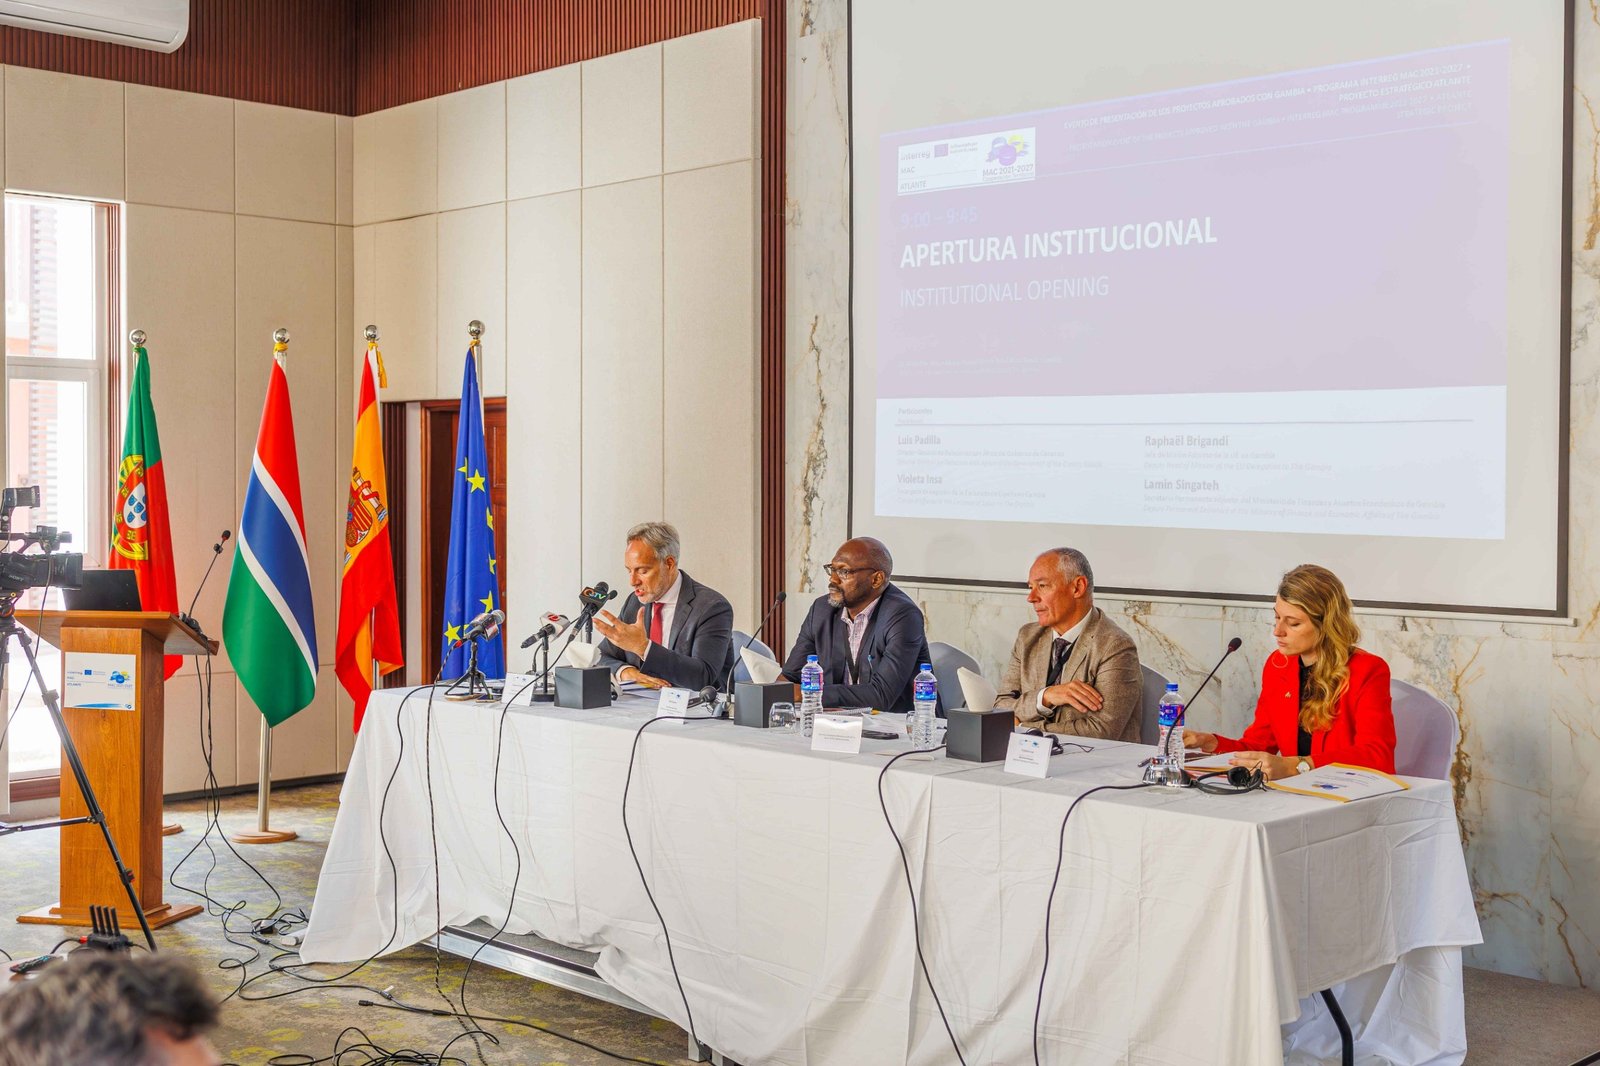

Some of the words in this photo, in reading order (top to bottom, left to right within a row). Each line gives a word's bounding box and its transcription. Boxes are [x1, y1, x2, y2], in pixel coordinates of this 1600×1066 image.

[1338, 89, 1379, 102] PROYECTO
[1433, 75, 1473, 88] ATLANTE
[1089, 117, 1098, 126] DE
[1149, 109, 1158, 118] DE
[1256, 91, 1273, 101] CON
[1274, 87, 1305, 99] GAMBIA
[1312, 79, 1359, 93] PROGRAMA
[1360, 72, 1398, 87] INTERREG
[1400, 69, 1419, 80] MAC
[900, 166, 915, 174] MAC
[982, 168, 998, 177] MAC
[999, 164, 1034, 175] 2021-2027
[900, 180, 927, 190] ATLANTE
[900, 210, 931, 228] 9:00
[946, 206, 977, 224] 9:45
[899, 234, 1018, 269] APERTURA
[1024, 215, 1218, 260] INSTITUCIONAL
[899, 281, 1022, 309] INSTITUTIONAL
[1026, 275, 1110, 300] OPENING
[897, 435, 914, 445] Luis
[915, 434, 941, 445] Padilla
[1144, 435, 1184, 448] Raphaël
[1186, 435, 1229, 448] Brigandi
[897, 474, 925, 484] Violeta
[926, 474, 943, 484] Insa
[1144, 479, 1173, 490] Lamin
[1176, 480, 1219, 492] Singateh
